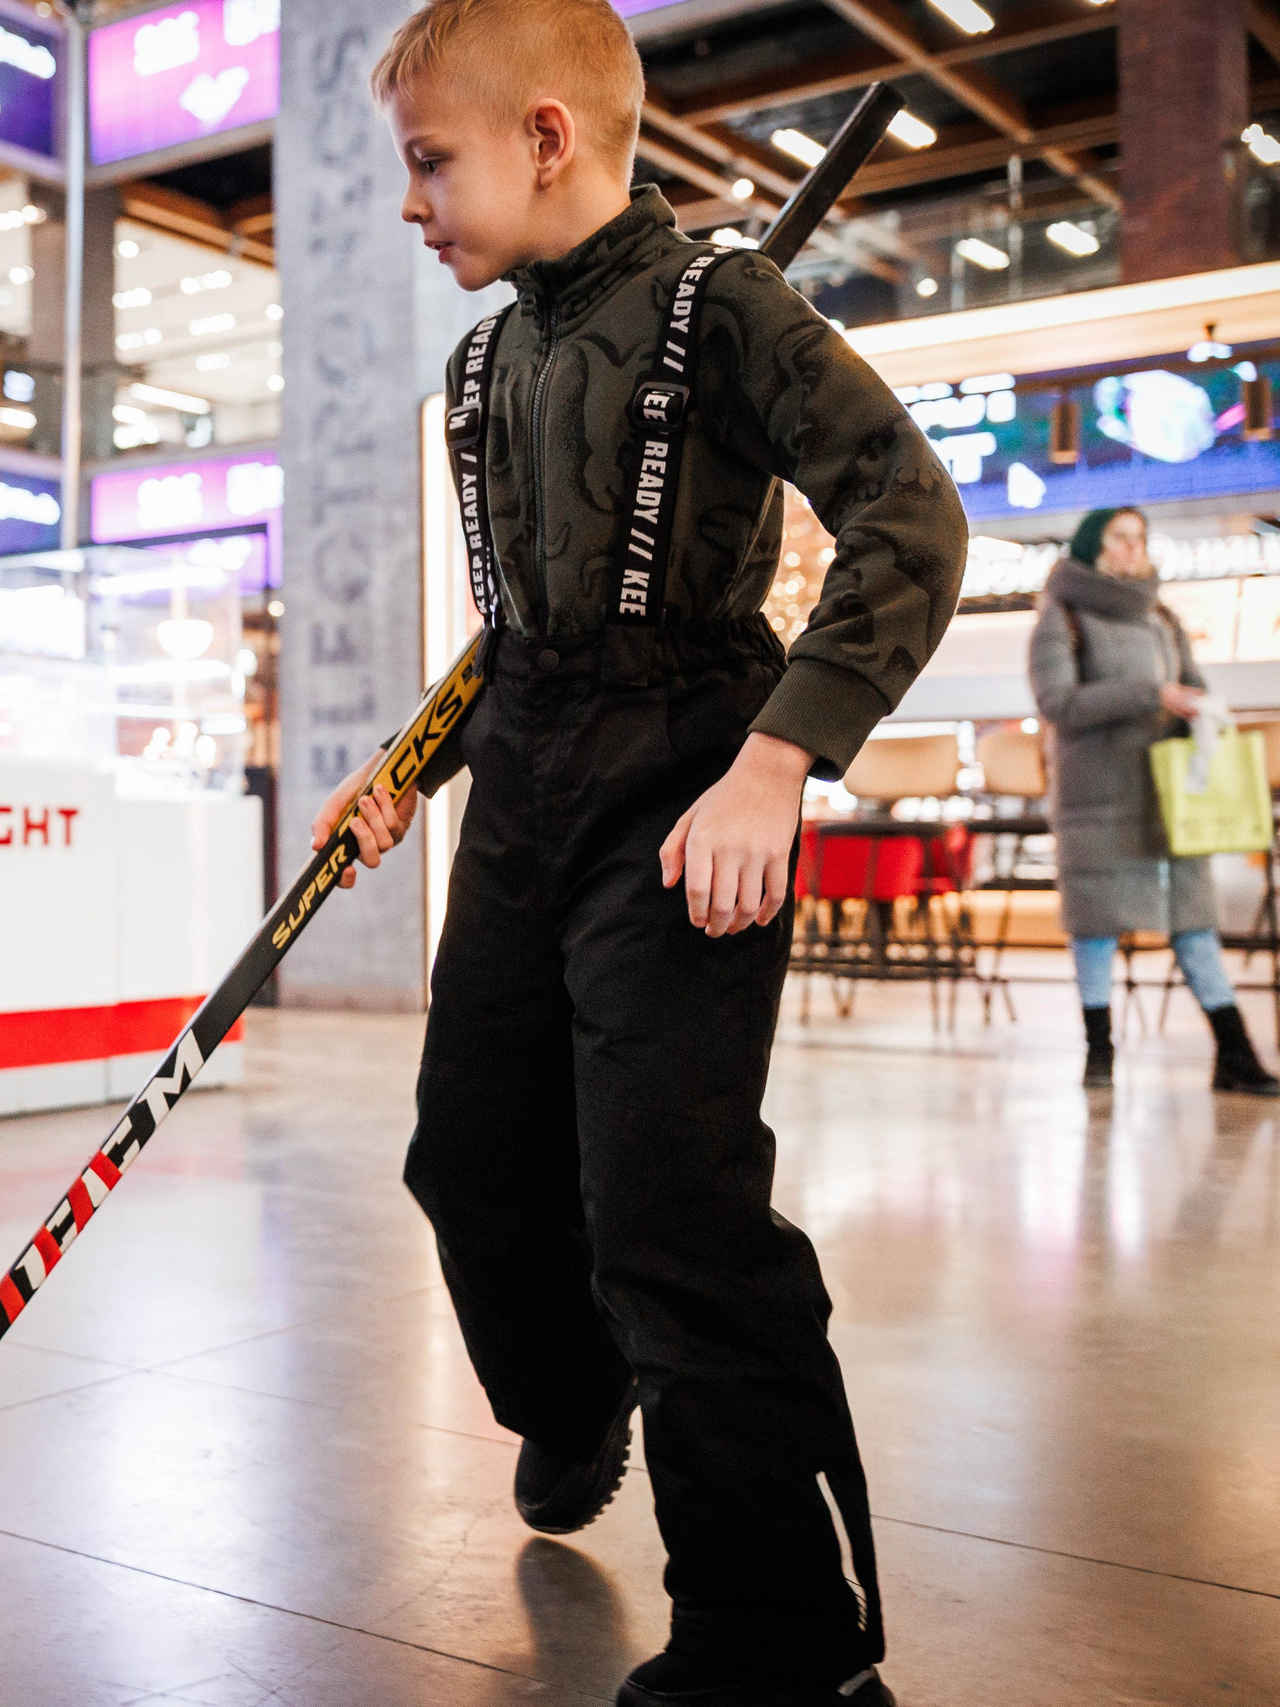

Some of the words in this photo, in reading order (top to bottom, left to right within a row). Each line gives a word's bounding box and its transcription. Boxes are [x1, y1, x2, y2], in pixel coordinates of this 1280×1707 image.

[670, 256, 716, 334] READY
[462, 473, 482, 549] READY
[633, 440, 669, 525] READY
[472, 555, 487, 614] KEEP
[619, 569, 650, 616] KEE
[272, 844, 347, 949] SUPER
[342, 685, 463, 836] CKS
